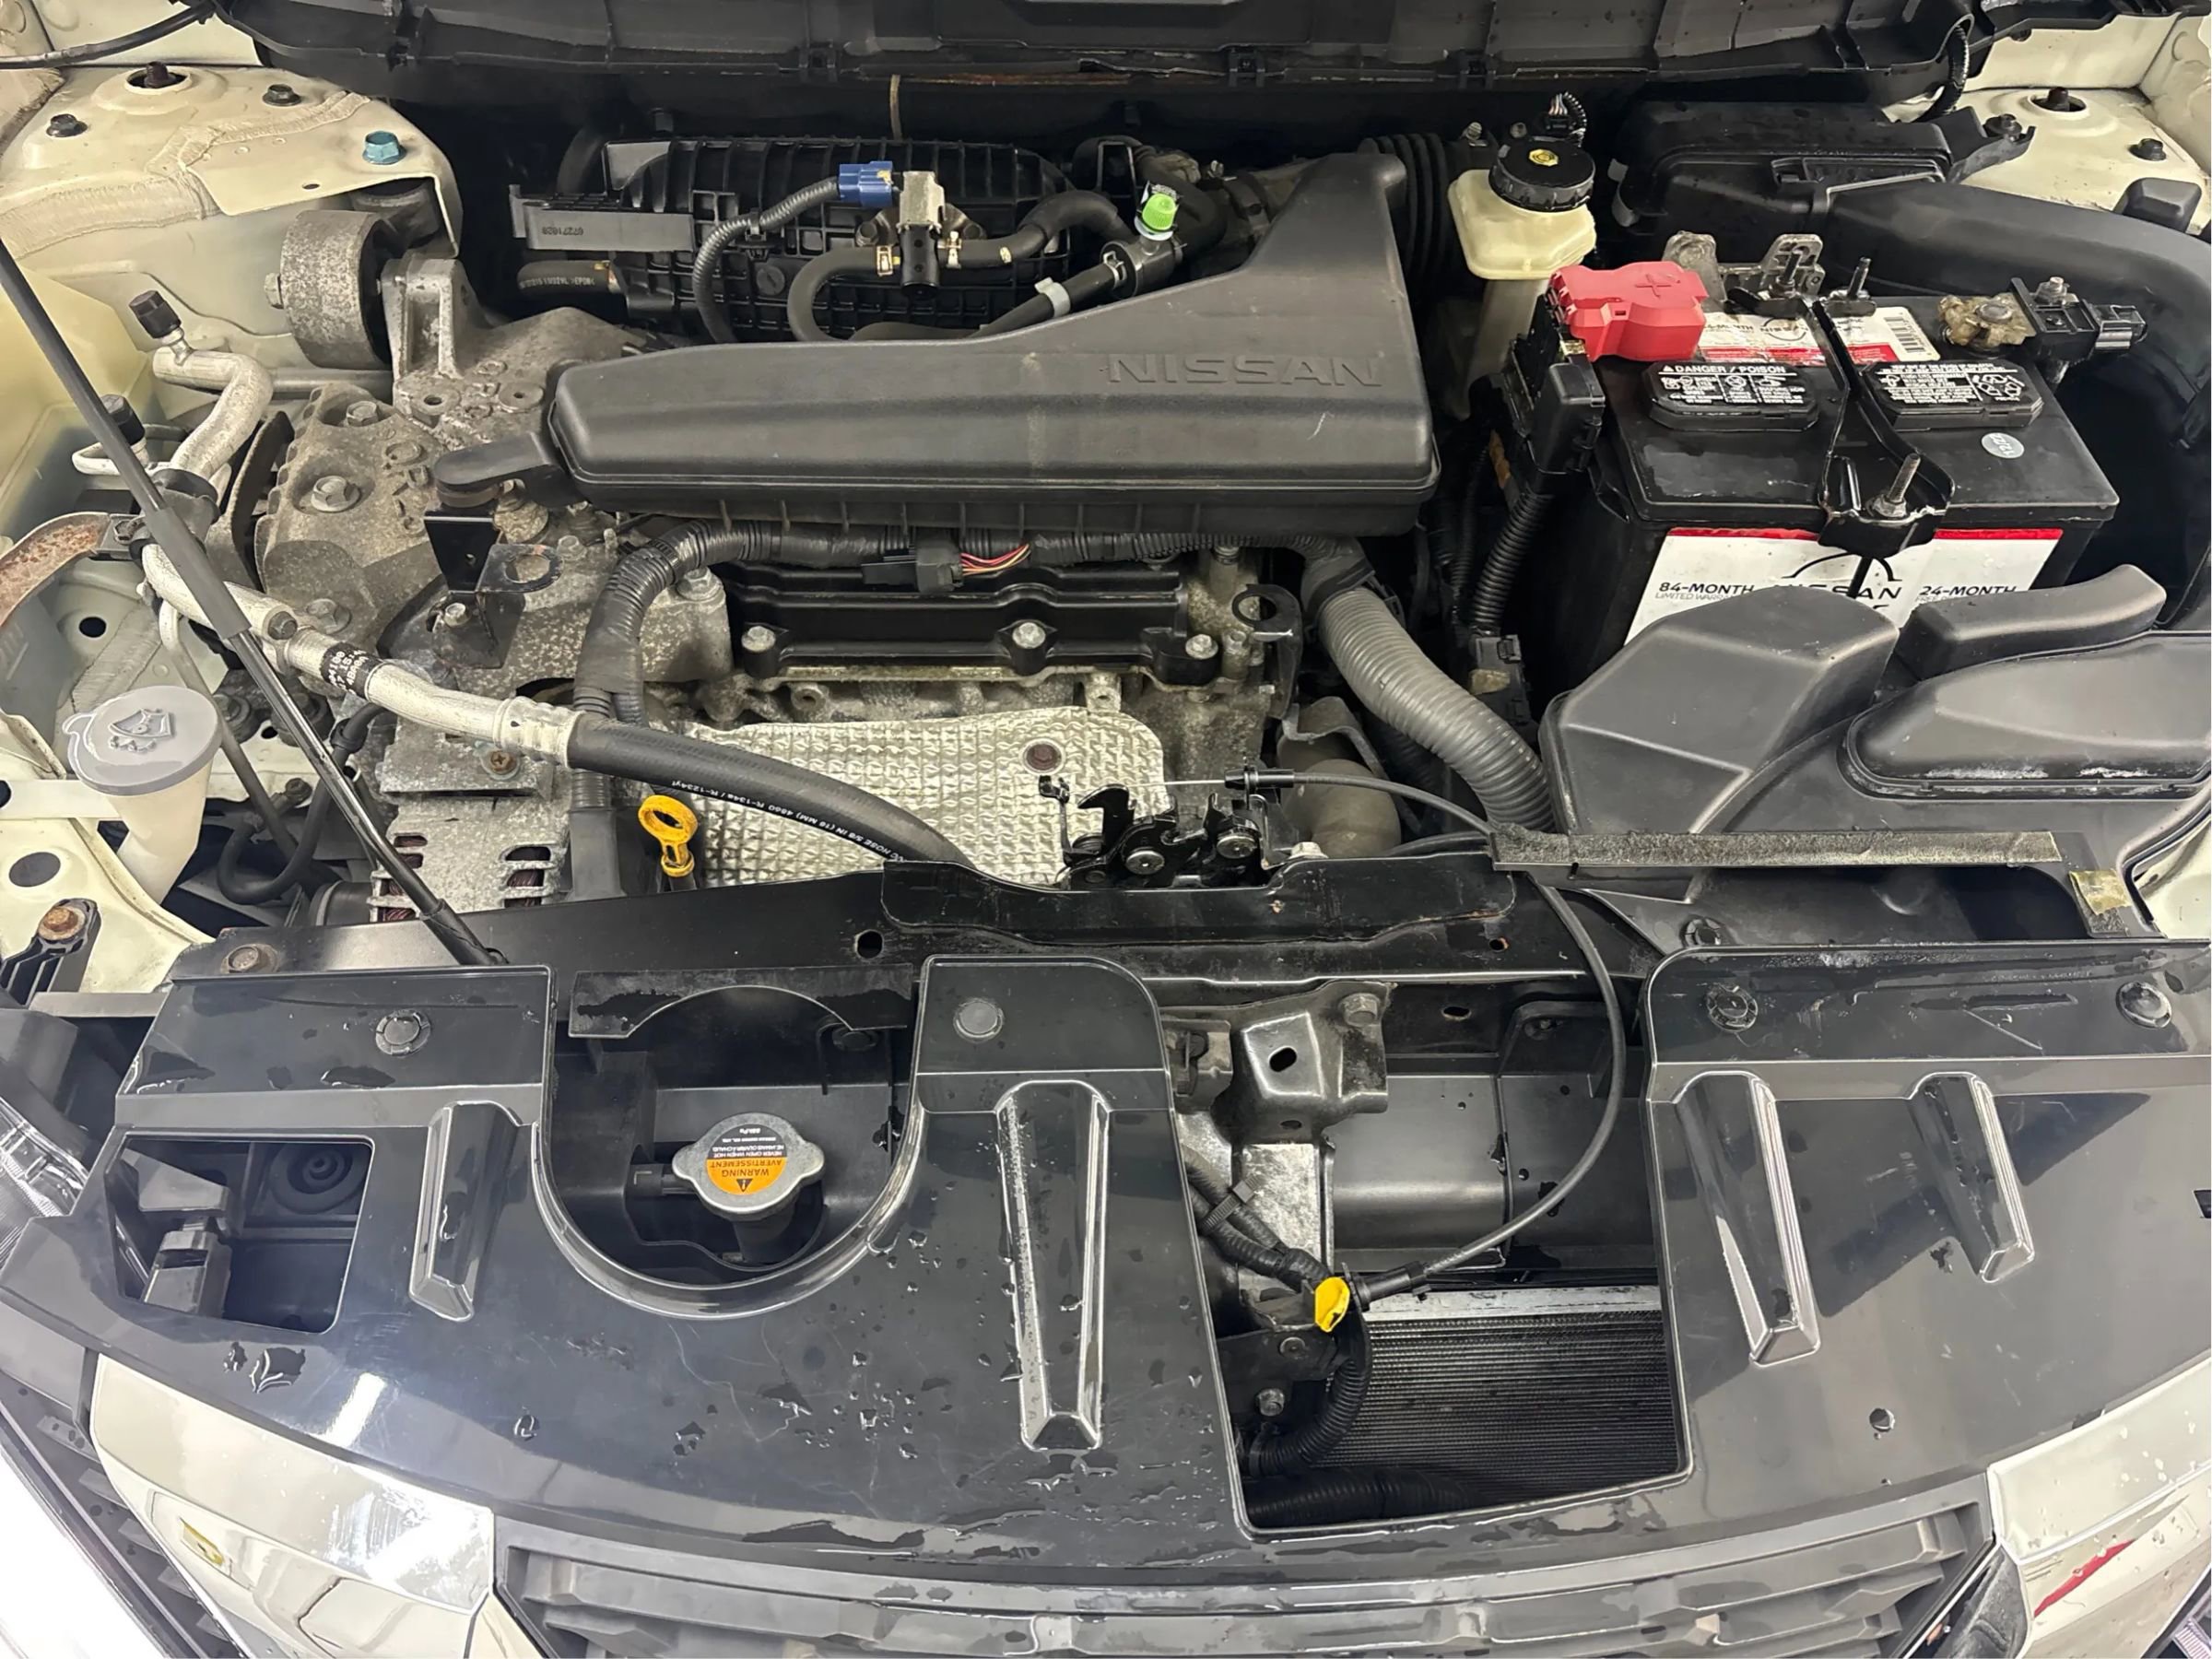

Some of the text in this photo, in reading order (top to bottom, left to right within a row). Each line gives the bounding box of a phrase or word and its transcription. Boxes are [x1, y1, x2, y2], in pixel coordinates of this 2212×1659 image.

[1108, 354, 1382, 387] NISSAN
[1659, 582, 1754, 595] 84-MONTH
[1920, 586, 2017, 595] 24-MONTH
[1654, 592, 1693, 600] LIMITED
[727, 794, 764, 808] R-134a
[796, 812, 818, 825] MM)
[836, 827, 848, 836] IN
[849, 831, 864, 842] 5/8
[865, 839, 891, 854] HOSE
[710, 1159, 782, 1168] AVERTISSEMENT
[722, 1169, 769, 1177] WARNING
